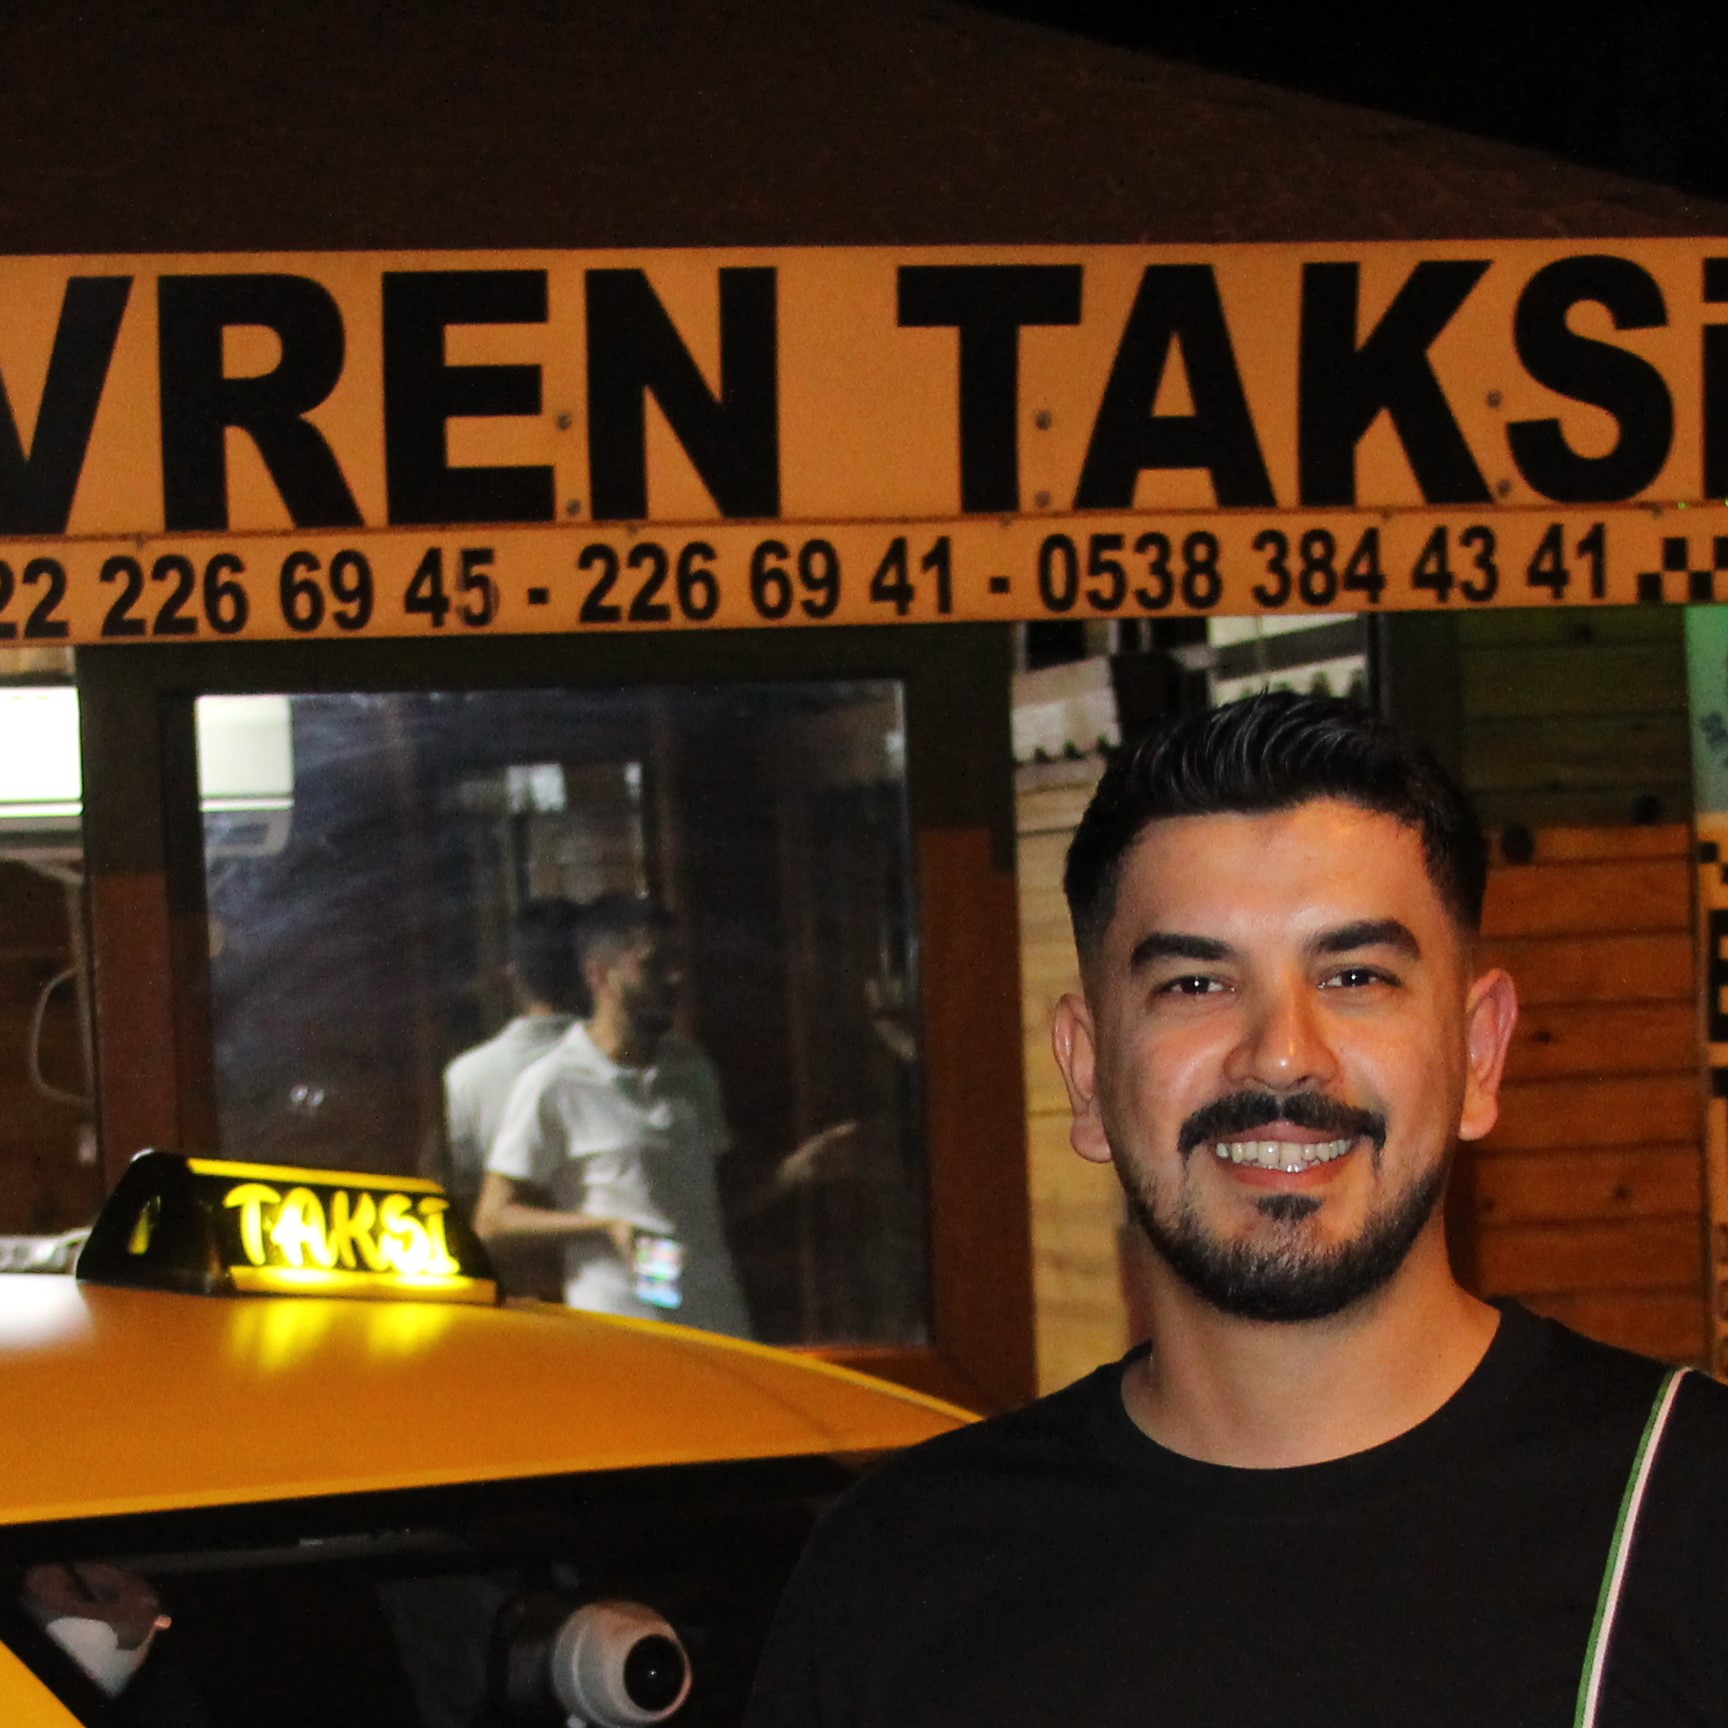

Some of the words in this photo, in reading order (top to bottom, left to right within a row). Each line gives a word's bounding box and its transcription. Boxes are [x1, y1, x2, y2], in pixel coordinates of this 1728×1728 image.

[99, 552, 249, 638] 226
[278, 548, 374, 634] 69
[404, 545, 499, 629] 45
[577, 540, 720, 625] 226
[749, 538, 842, 622] 69
[871, 535, 953, 617] 41
[1037, 530, 1223, 613] 0538
[1251, 527, 1386, 609] 384
[1412, 524, 1498, 603] 43
[1526, 521, 1607, 601] 41
